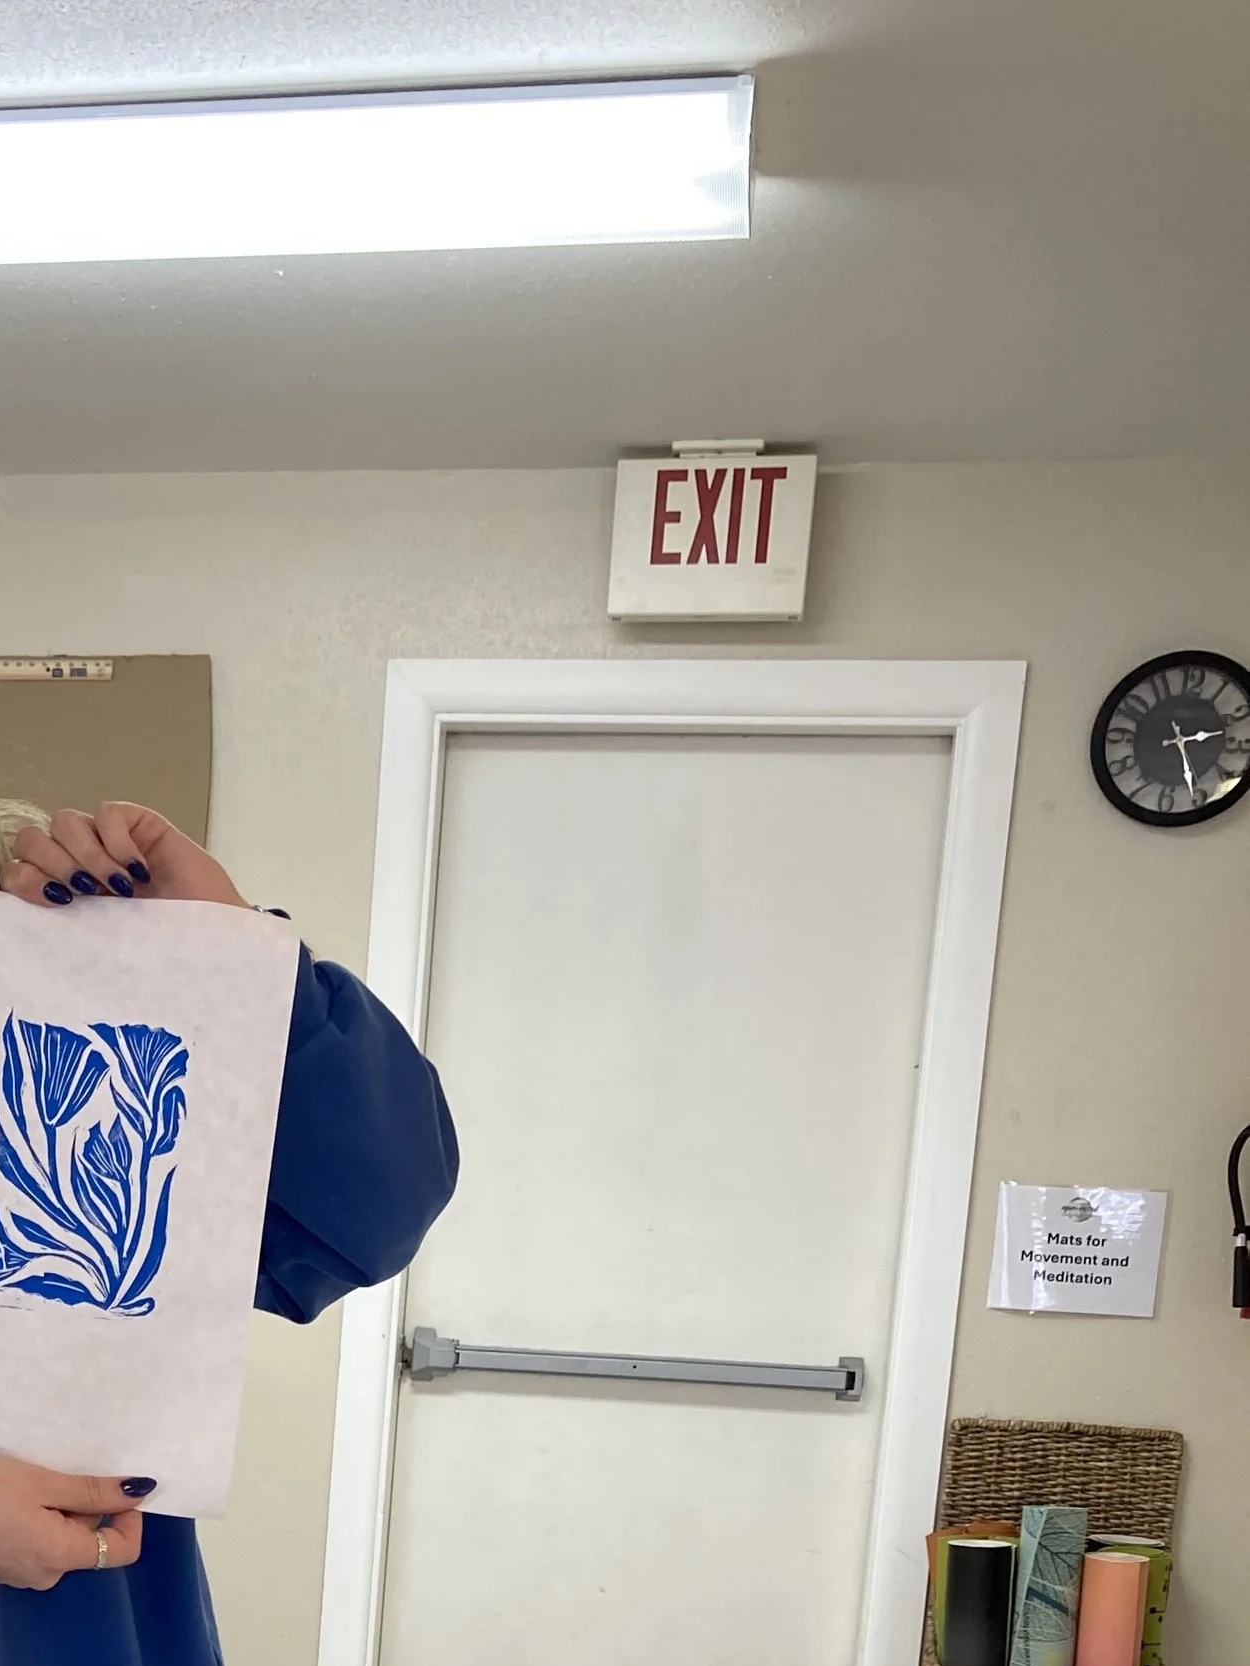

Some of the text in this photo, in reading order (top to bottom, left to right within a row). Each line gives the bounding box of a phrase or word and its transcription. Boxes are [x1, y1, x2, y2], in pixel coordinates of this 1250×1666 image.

[650, 467, 788, 565] EXIT
[1181, 667, 1206, 698] 12
[1106, 727, 1135, 744] 9
[1109, 755, 1136, 776] 8
[1158, 785, 1175, 812] 6
[1047, 1233, 1107, 1247] Mats for
[1021, 1250, 1129, 1267] Movement and
[1033, 1270, 1112, 1285] Meditation
